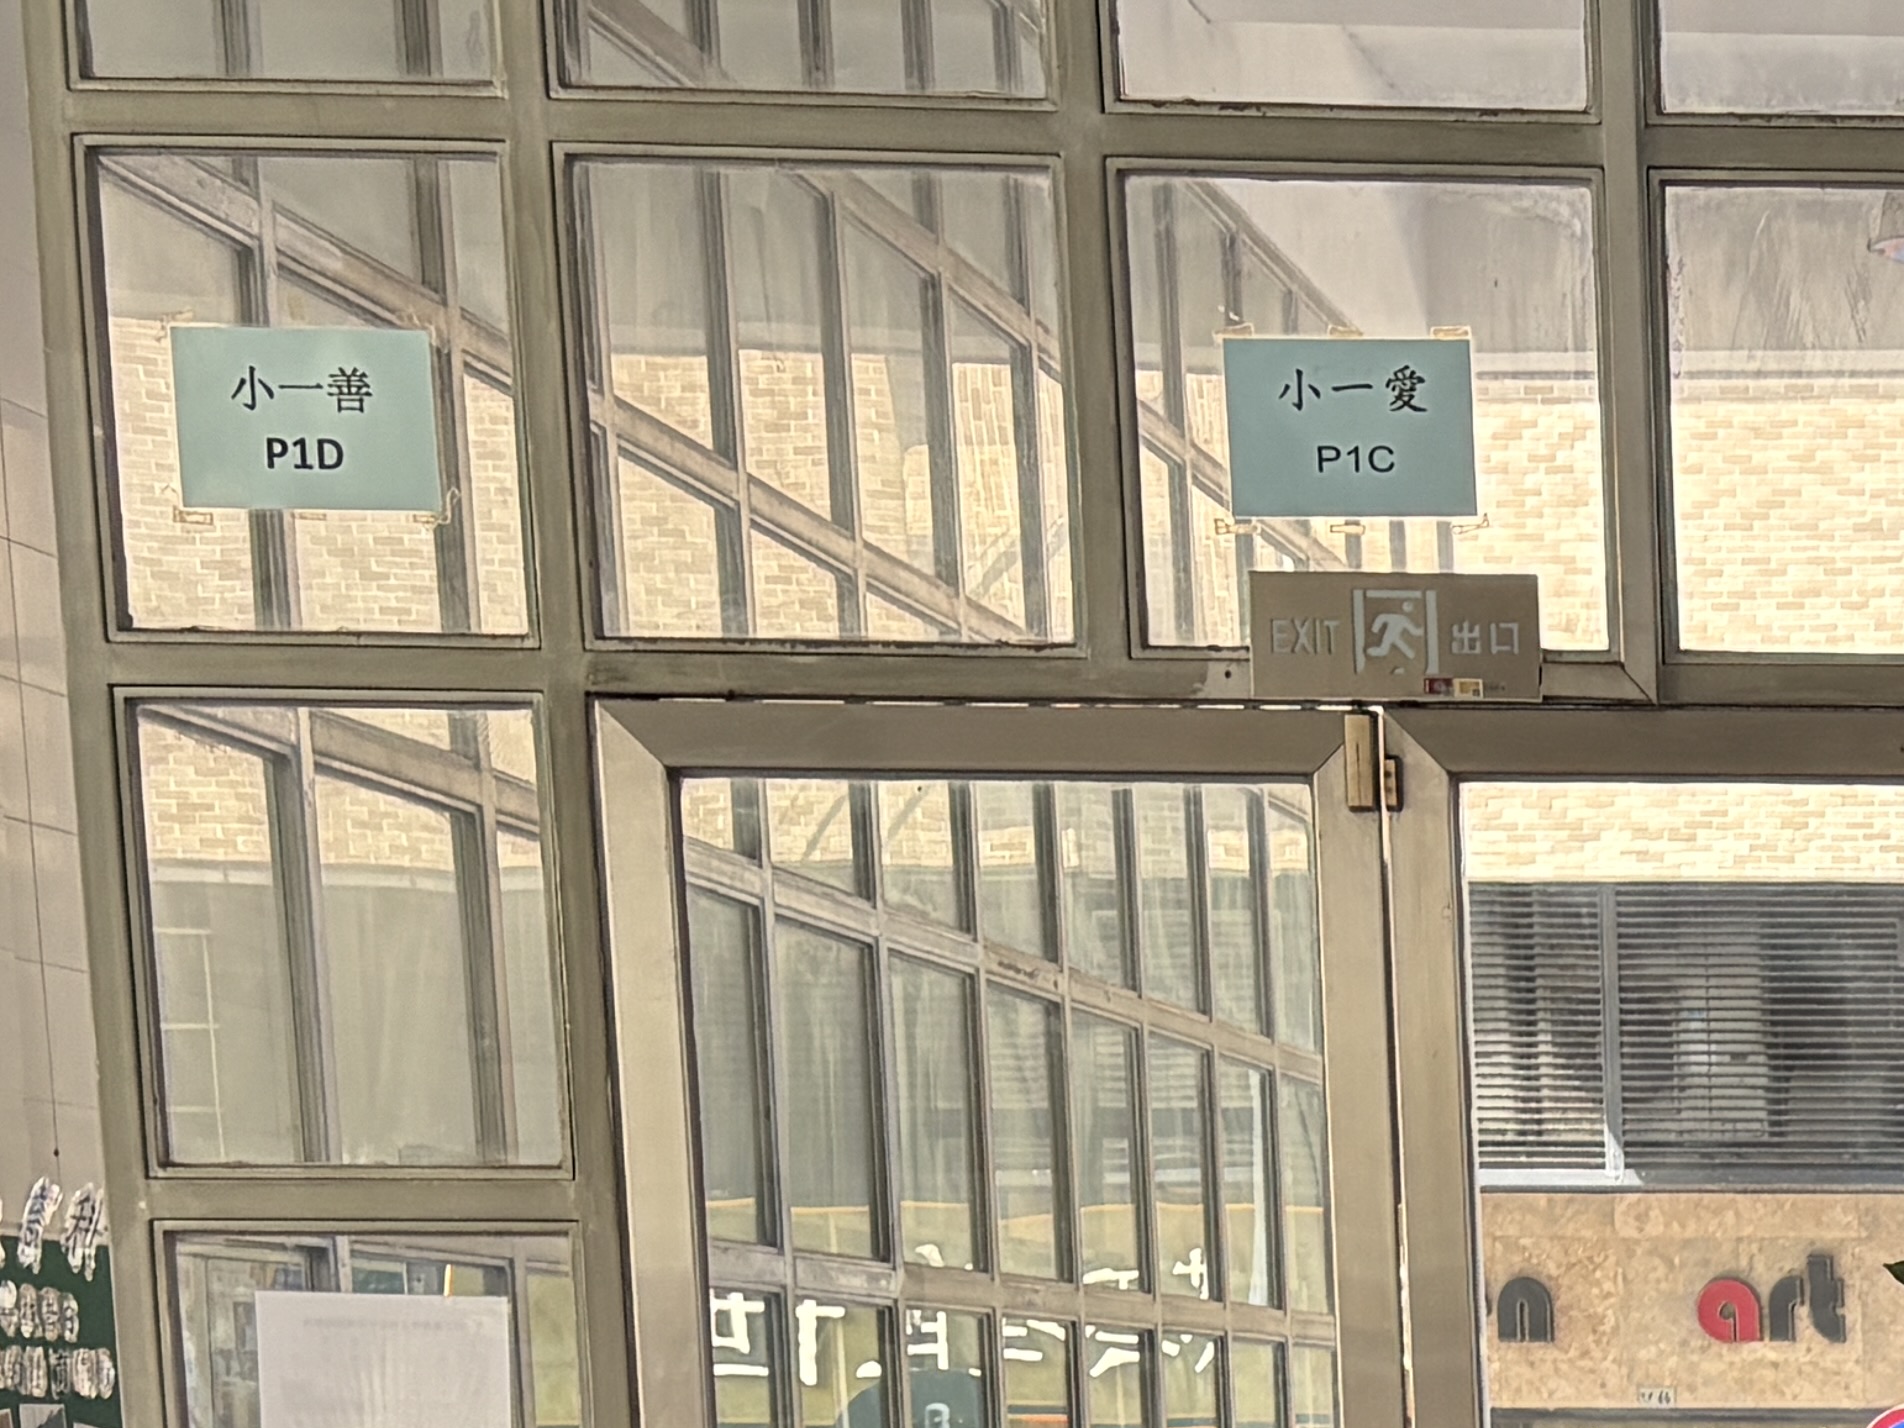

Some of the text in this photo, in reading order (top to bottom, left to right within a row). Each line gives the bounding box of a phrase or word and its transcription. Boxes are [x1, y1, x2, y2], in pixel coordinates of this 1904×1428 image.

[231, 365, 374, 414] 小一善
[1278, 364, 1429, 413] 小一愛
[265, 437, 345, 471] P1D
[1316, 445, 1396, 473] P1C
[1269, 618, 1342, 655] EXIT
[1451, 621, 1520, 655] 出口
[1488, 1253, 1848, 1344] n art
